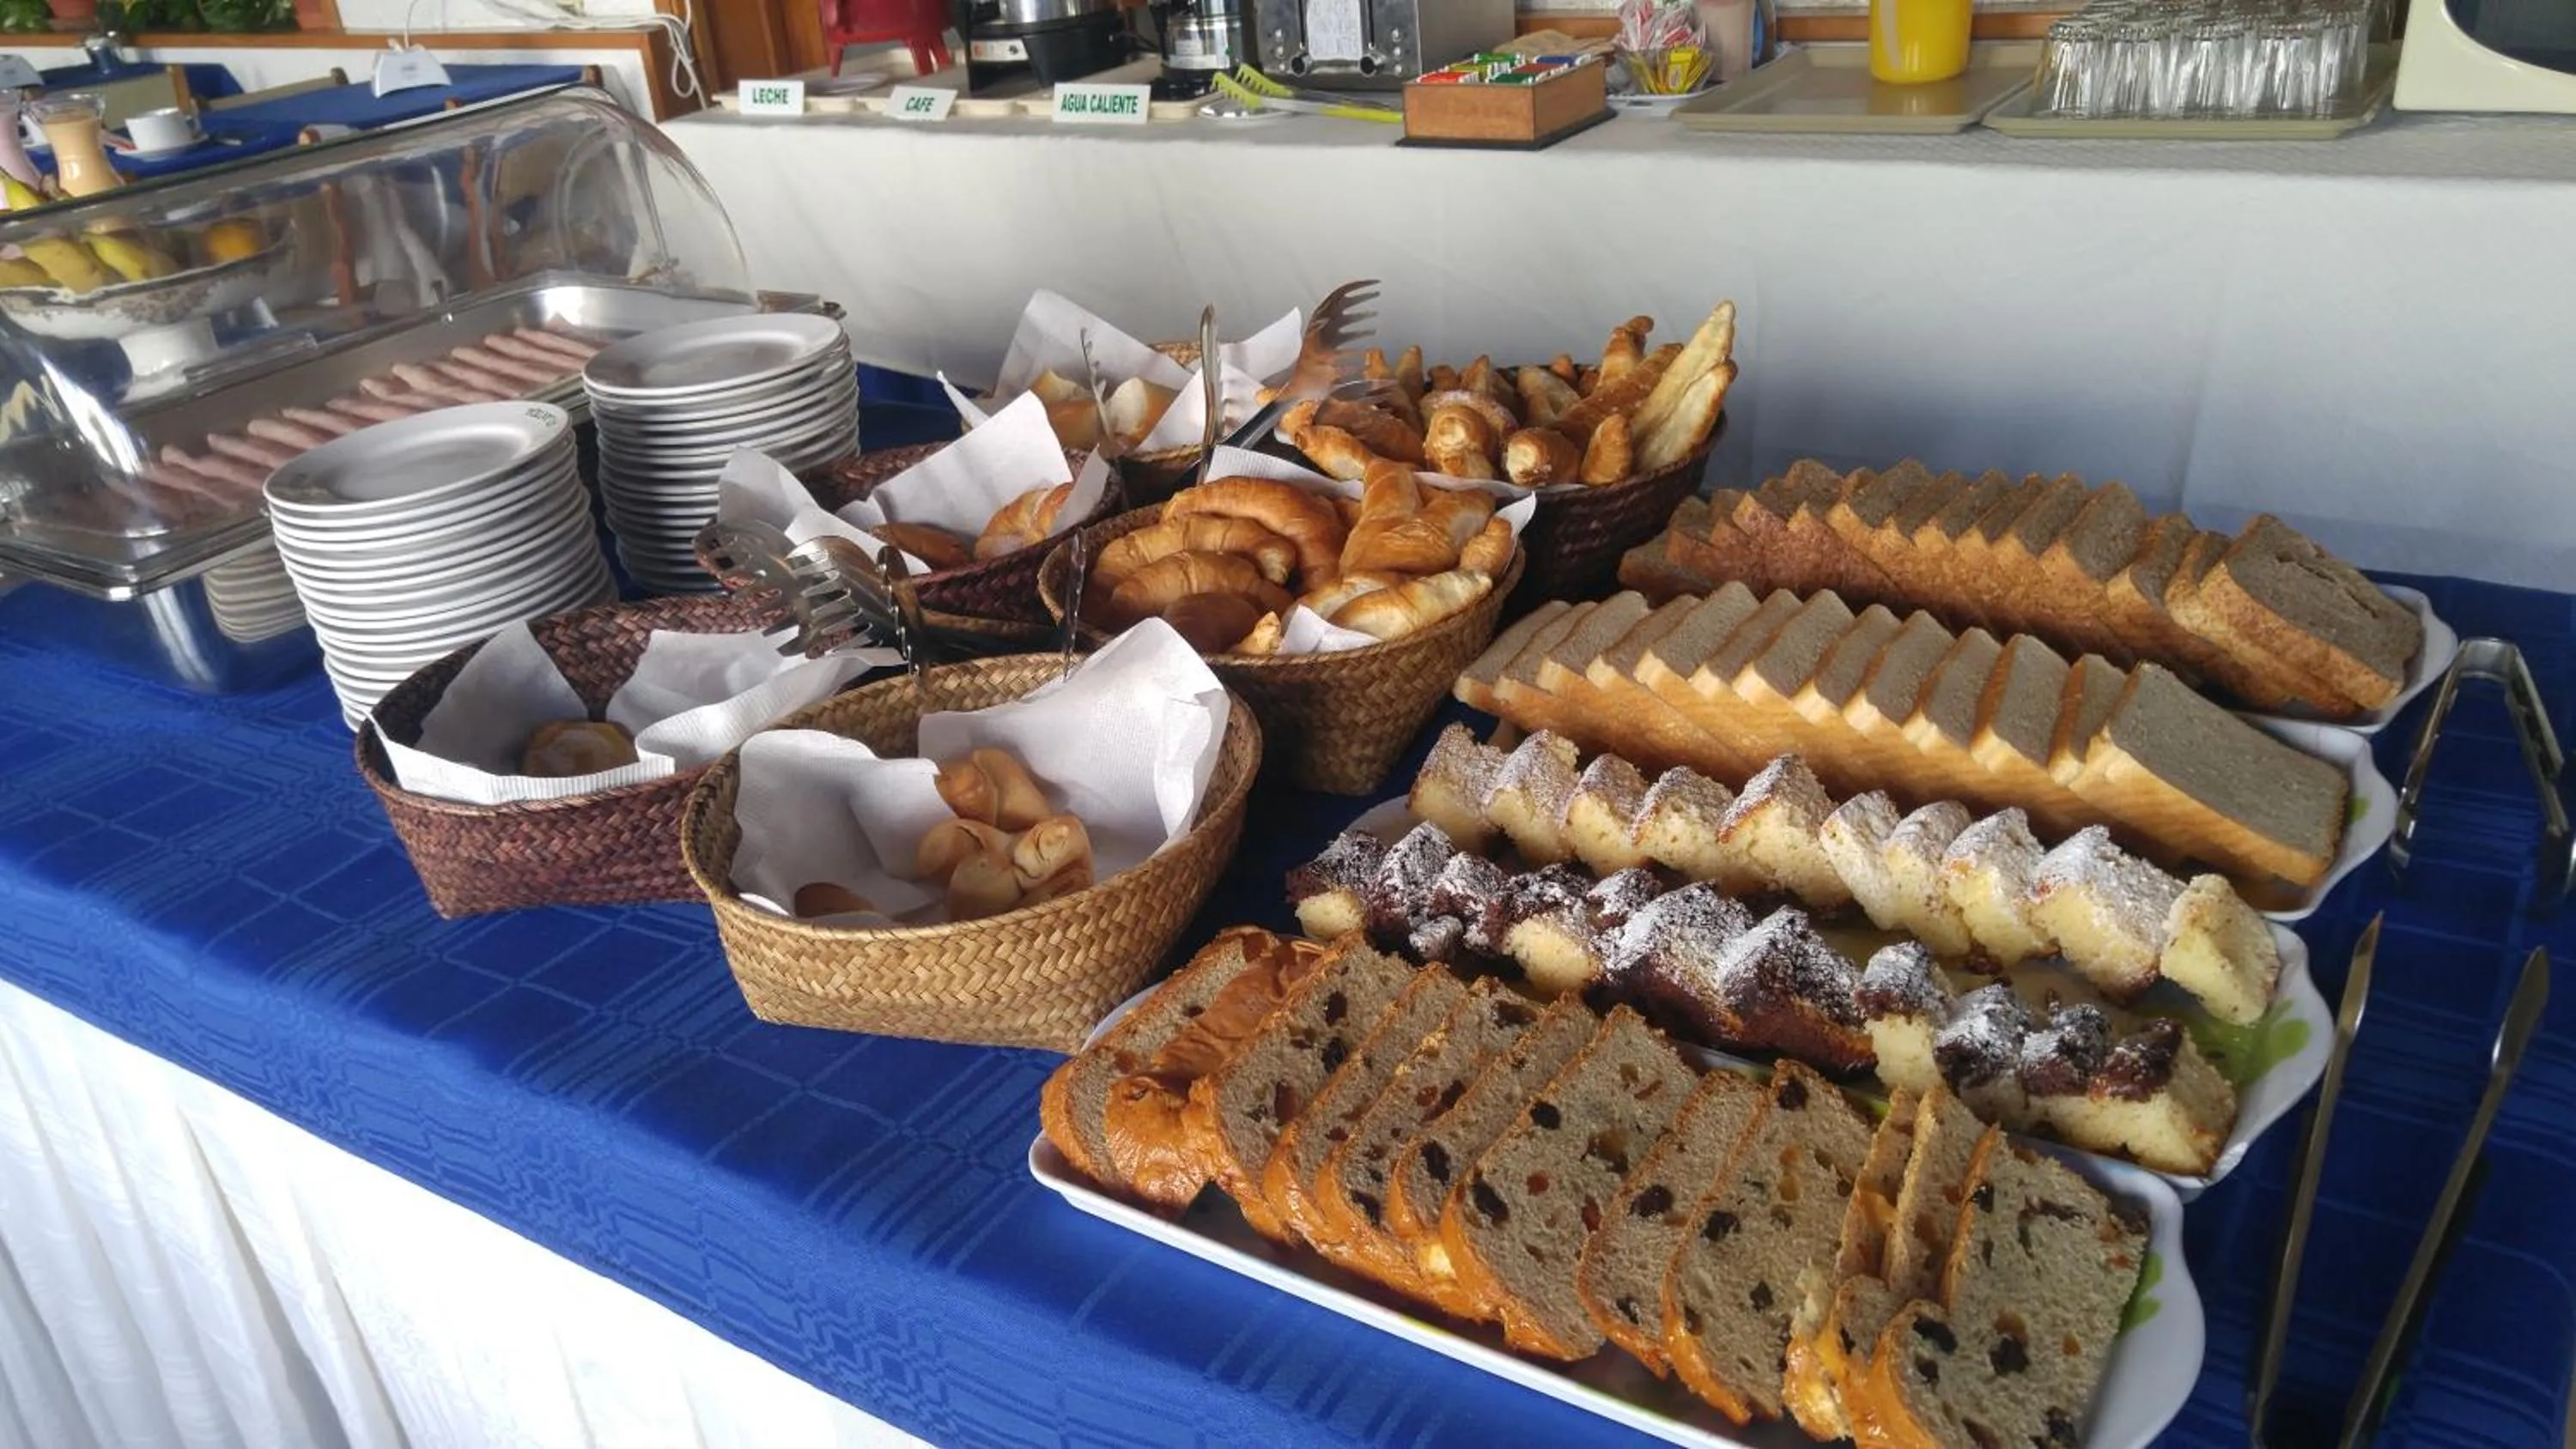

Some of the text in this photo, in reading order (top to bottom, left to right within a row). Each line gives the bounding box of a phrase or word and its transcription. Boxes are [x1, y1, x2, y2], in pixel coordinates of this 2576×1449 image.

[752, 88, 789, 104] LECHE
[906, 96, 934, 112] CAFE
[1060, 94, 1139, 113] AGUA CALIENTE
